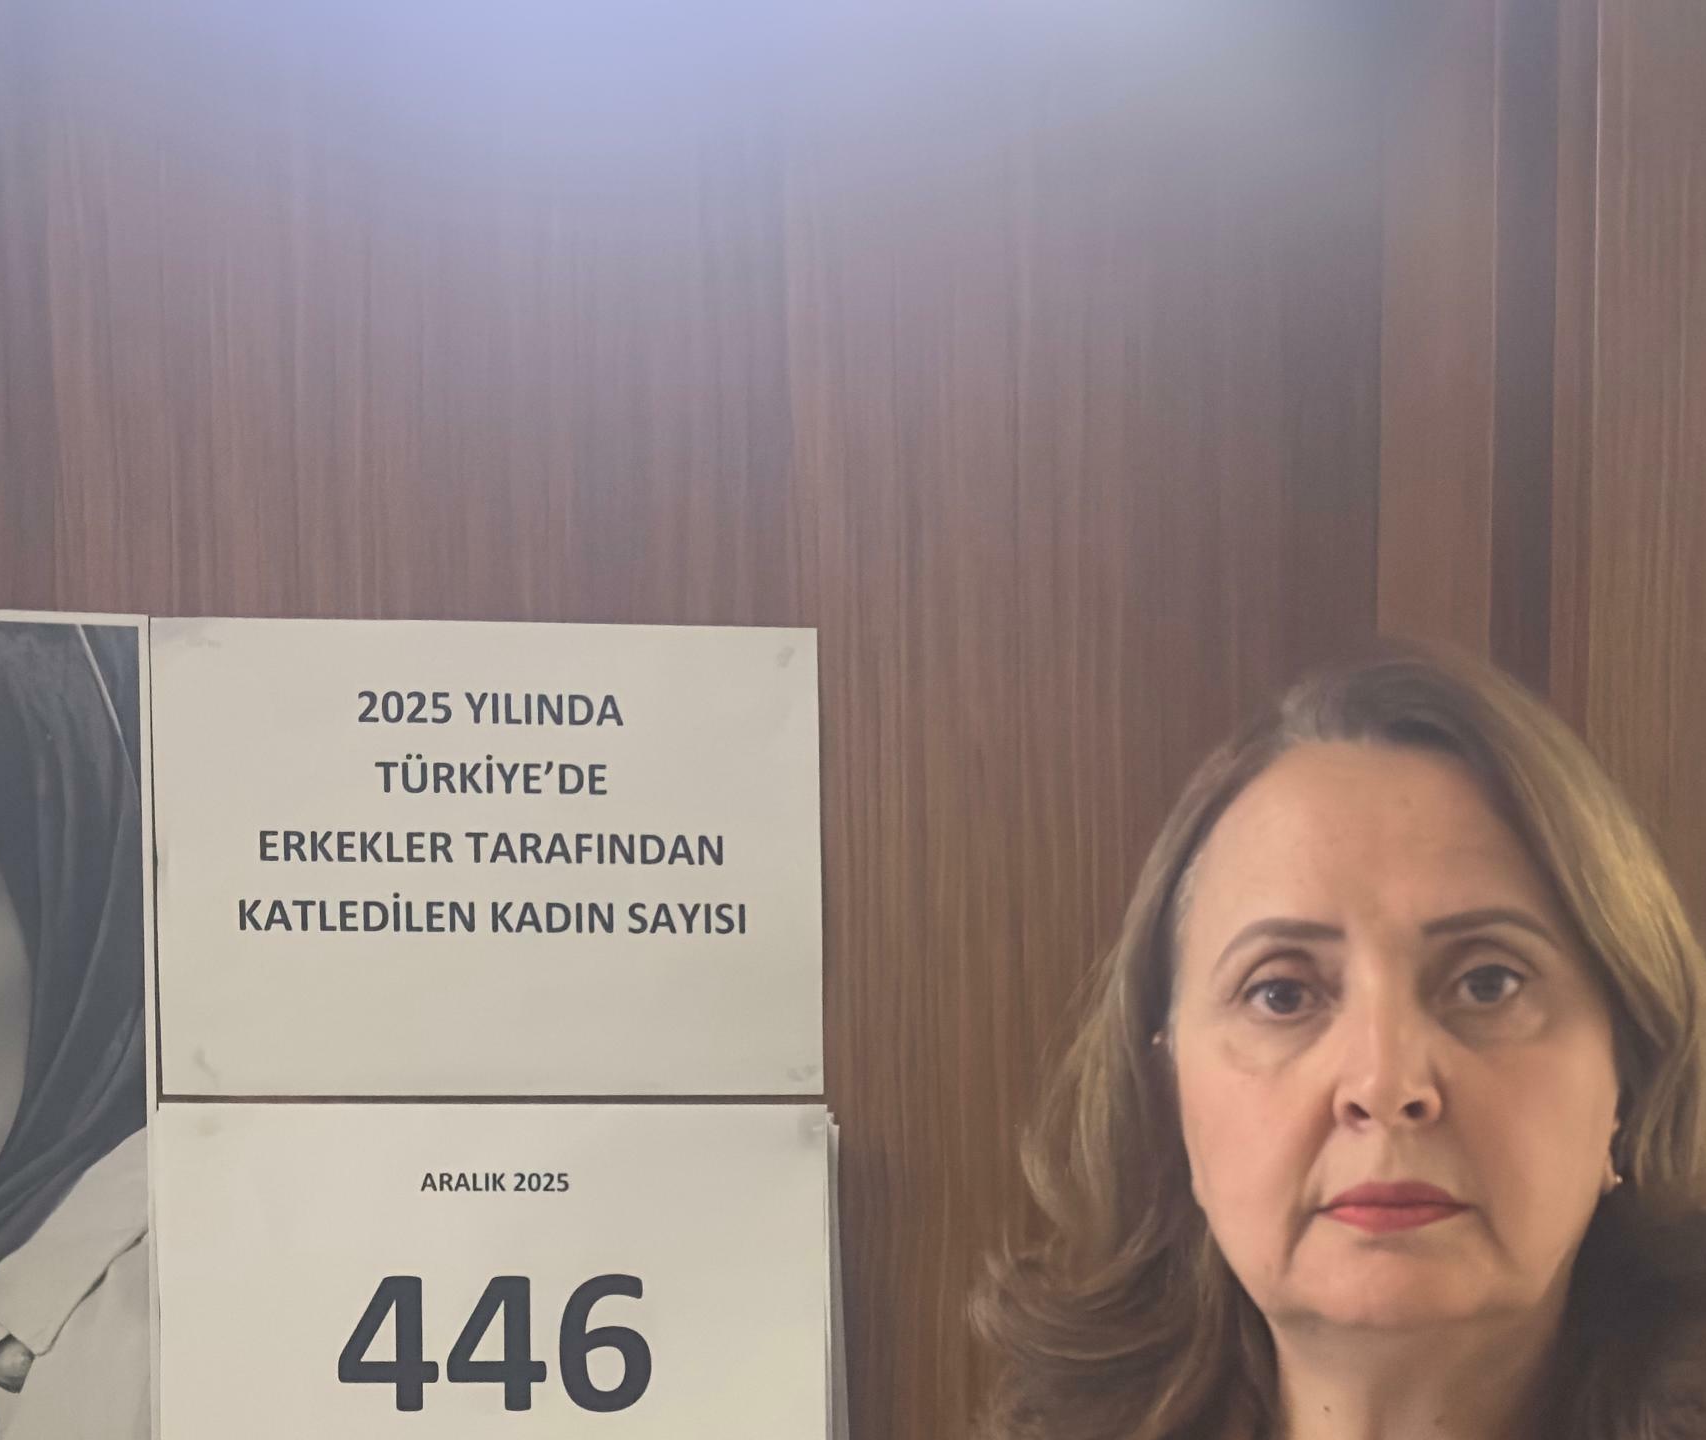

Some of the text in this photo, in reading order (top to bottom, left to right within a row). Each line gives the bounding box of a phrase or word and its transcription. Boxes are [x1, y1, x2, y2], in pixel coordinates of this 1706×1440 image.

[358, 690, 624, 727] 2025 YILINDA
[374, 753, 608, 796] TÜRKİYE’DE
[259, 830, 724, 866] ERKEKLER TARAFINDAN
[238, 892, 746, 935] KATLEDİLEN KADIN SAYISI
[420, 1172, 569, 1193] ARALIK 2025
[337, 1273, 652, 1413] 446
